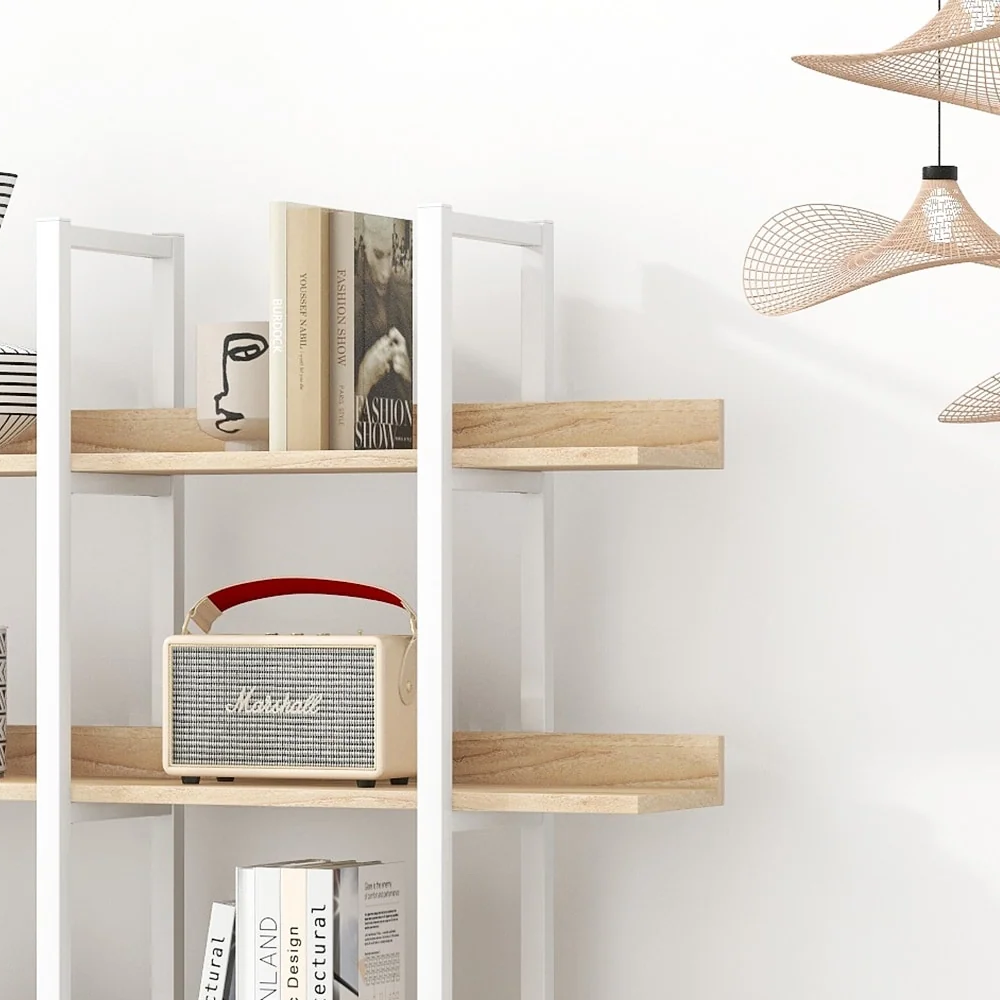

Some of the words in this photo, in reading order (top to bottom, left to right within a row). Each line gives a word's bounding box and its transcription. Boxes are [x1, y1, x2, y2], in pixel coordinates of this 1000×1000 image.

[299, 273, 307, 317] YOUSSEF
[337, 269, 347, 324] FASHION
[272, 298, 283, 353] BURDOCK
[299, 320, 307, 349] NABIL
[337, 329, 347, 367] SHOW
[355, 395, 413, 426] FASHION
[355, 421, 395, 449] SHOW
[226, 686, 323, 714] Marshall
[287, 926, 302, 988] Design
